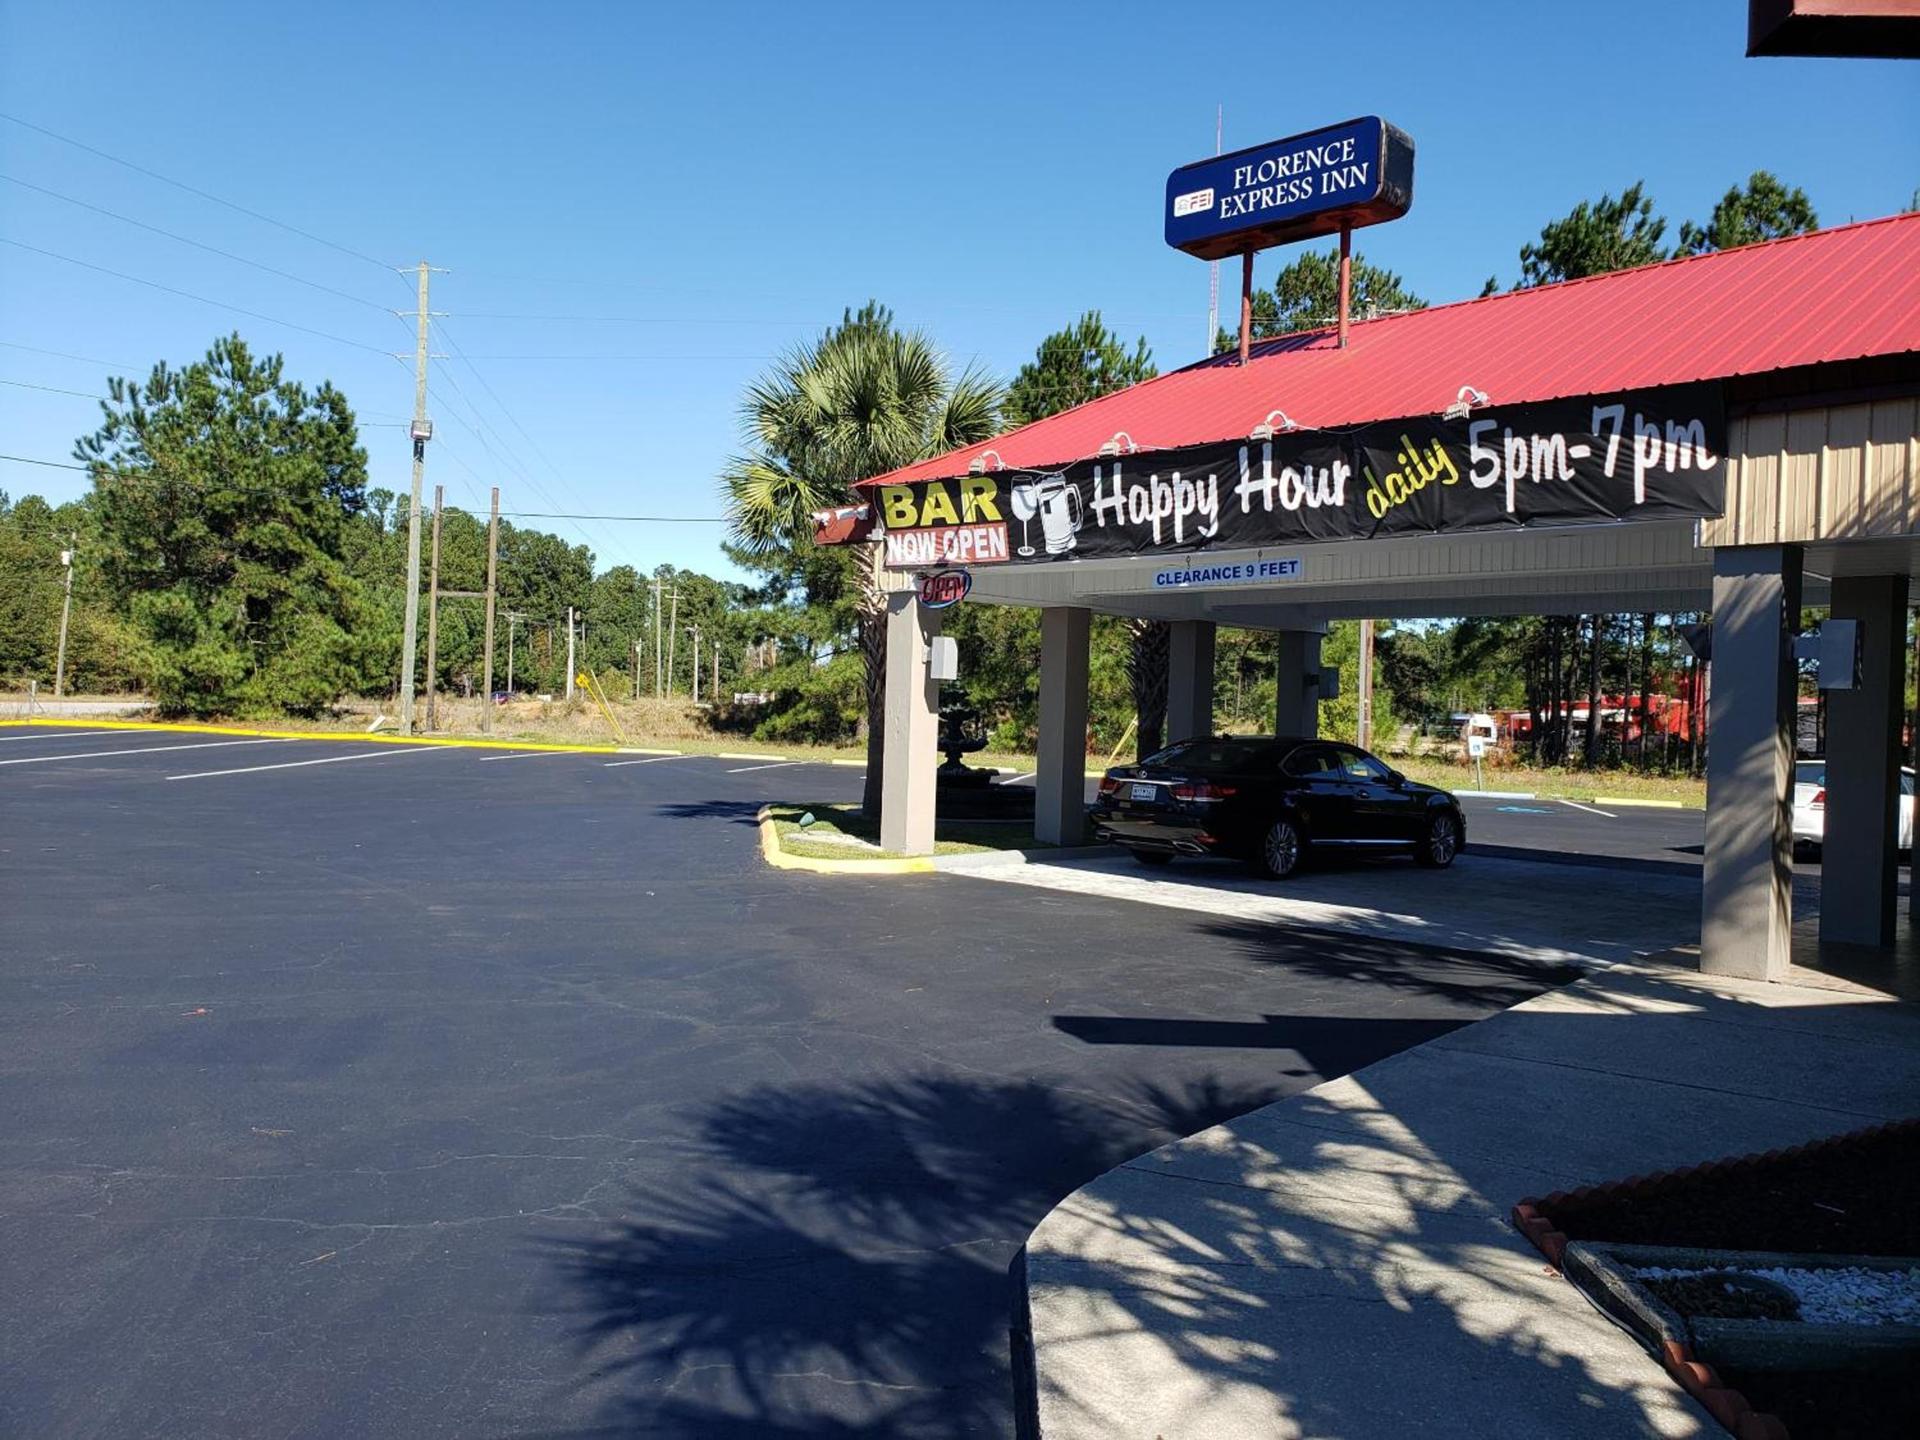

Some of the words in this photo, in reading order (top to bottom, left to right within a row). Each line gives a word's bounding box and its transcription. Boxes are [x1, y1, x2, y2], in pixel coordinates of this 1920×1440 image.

[1233, 137, 1356, 189] FLORENCE
[1190, 191, 1212, 210] FEI
[1218, 176, 1313, 219] EXPRESS
[1321, 162, 1370, 194] INN
[881, 476, 1003, 529] BAR
[1089, 461, 1220, 546] Happy
[1234, 441, 1351, 514] Hour
[1364, 433, 1460, 520] daily
[887, 531, 938, 563] NOW
[942, 526, 1007, 560] OPEN
[922, 576, 965, 602] OPEN
[1156, 565, 1241, 586] CLEARANCE
[1246, 564, 1255, 577] 9
[1259, 560, 1299, 576] FEET
